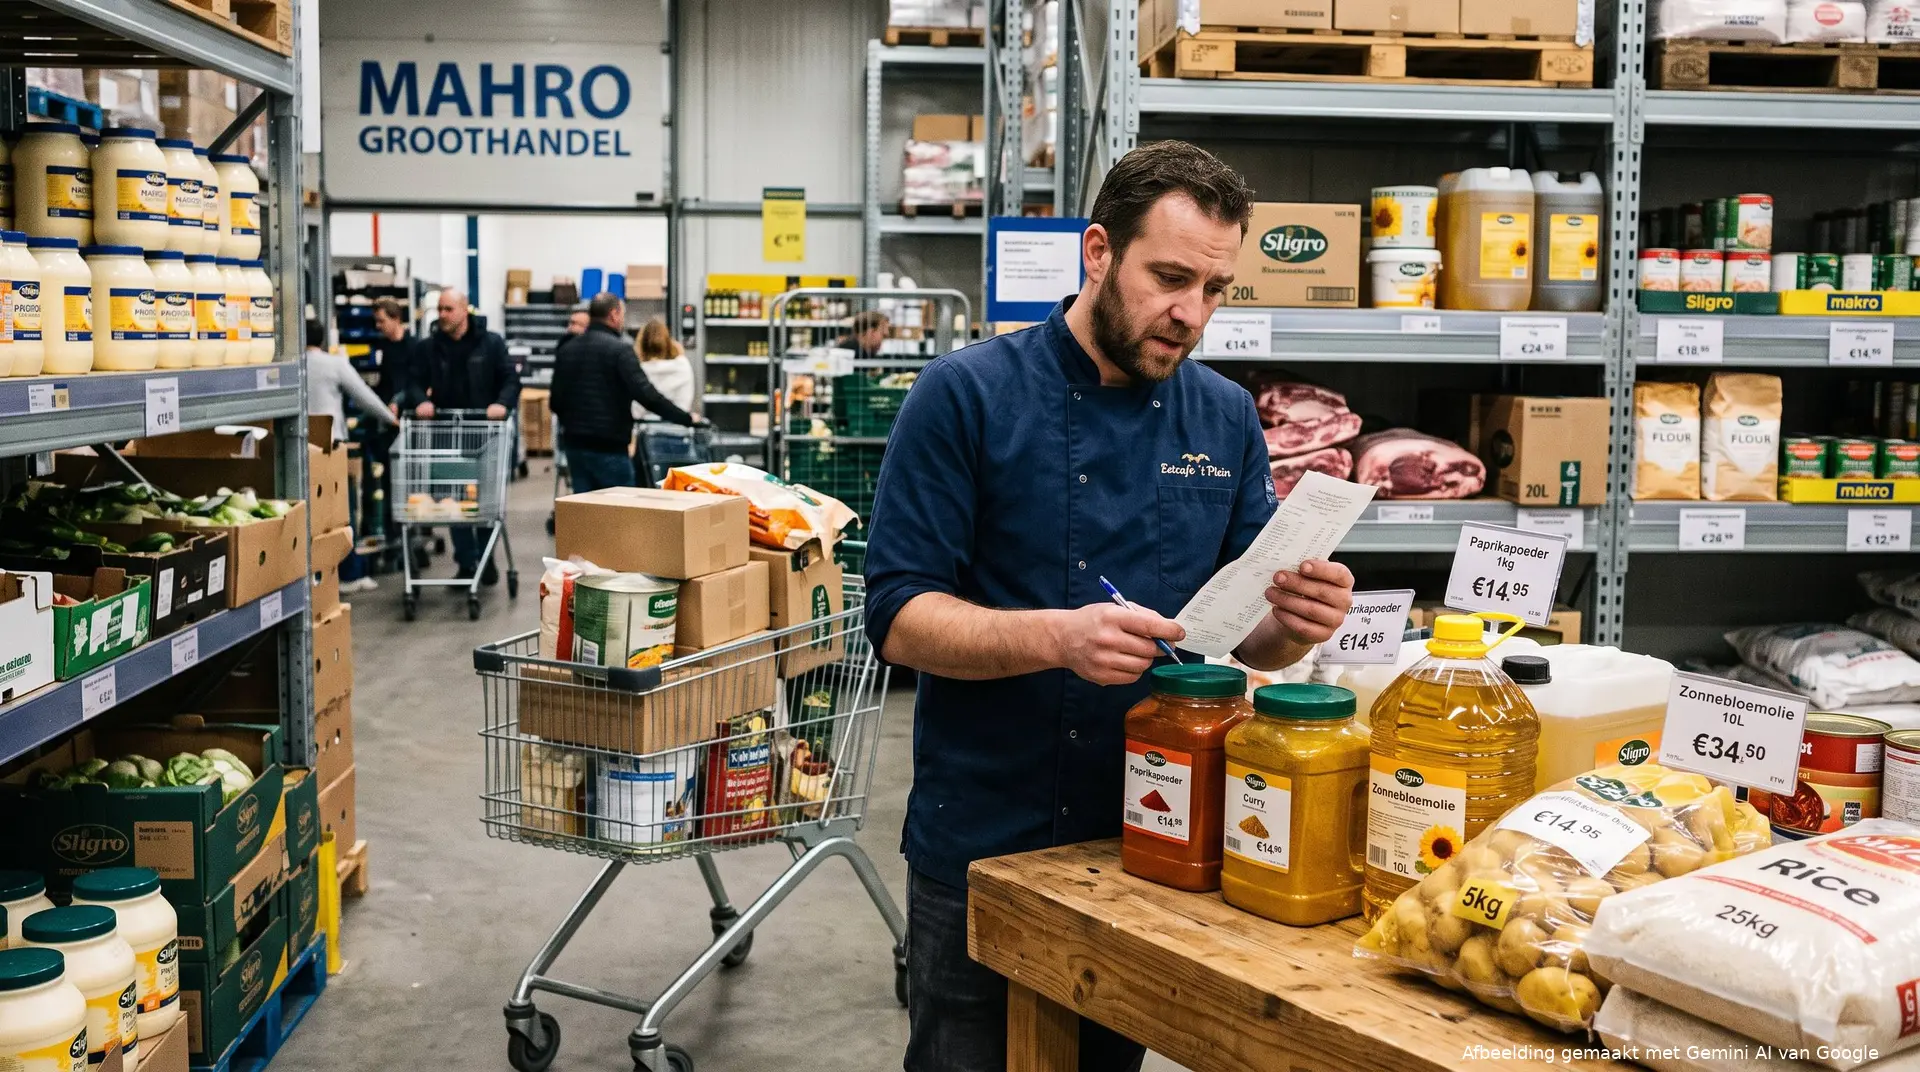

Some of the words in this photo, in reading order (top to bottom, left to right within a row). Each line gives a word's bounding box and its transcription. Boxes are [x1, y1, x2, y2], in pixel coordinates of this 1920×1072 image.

[359, 60, 631, 120] MAHRO
[359, 126, 631, 157] GROOTHANDEL
[1263, 233, 1326, 256] Sligro
[1232, 286, 1258, 301] 20L
[1686, 294, 1734, 312] Sligro
[1831, 296, 1879, 310] makro
[1652, 433, 1692, 442] FLOUR
[1730, 434, 1771, 444] FLOUR
[1160, 463, 1195, 477] Eetcafe
[1206, 465, 1232, 477] Plein
[1525, 484, 1549, 498] 20L
[1840, 484, 1890, 498] makro
[1470, 536, 1549, 560] Paprikapoeder
[1496, 557, 1515, 572] 1kg
[1472, 577, 1529, 602] €14.95
[1339, 632, 1385, 651] €14.95
[1679, 685, 1795, 721] Zonnebloemolie
[1722, 712, 1745, 727] 10L
[1620, 747, 1649, 764] Sligro
[1129, 765, 1183, 785] Paprikapoeder
[1243, 793, 1266, 809] Curry
[1372, 783, 1456, 811] Zonnebloemolie
[1533, 810, 1602, 839] €14.95
[57, 834, 125, 855] Sligro
[1393, 861, 1409, 875] 10L
[1758, 858, 1880, 907] Rice
[1462, 886, 1504, 920] 5kg
[1715, 904, 1779, 939] 25kg
